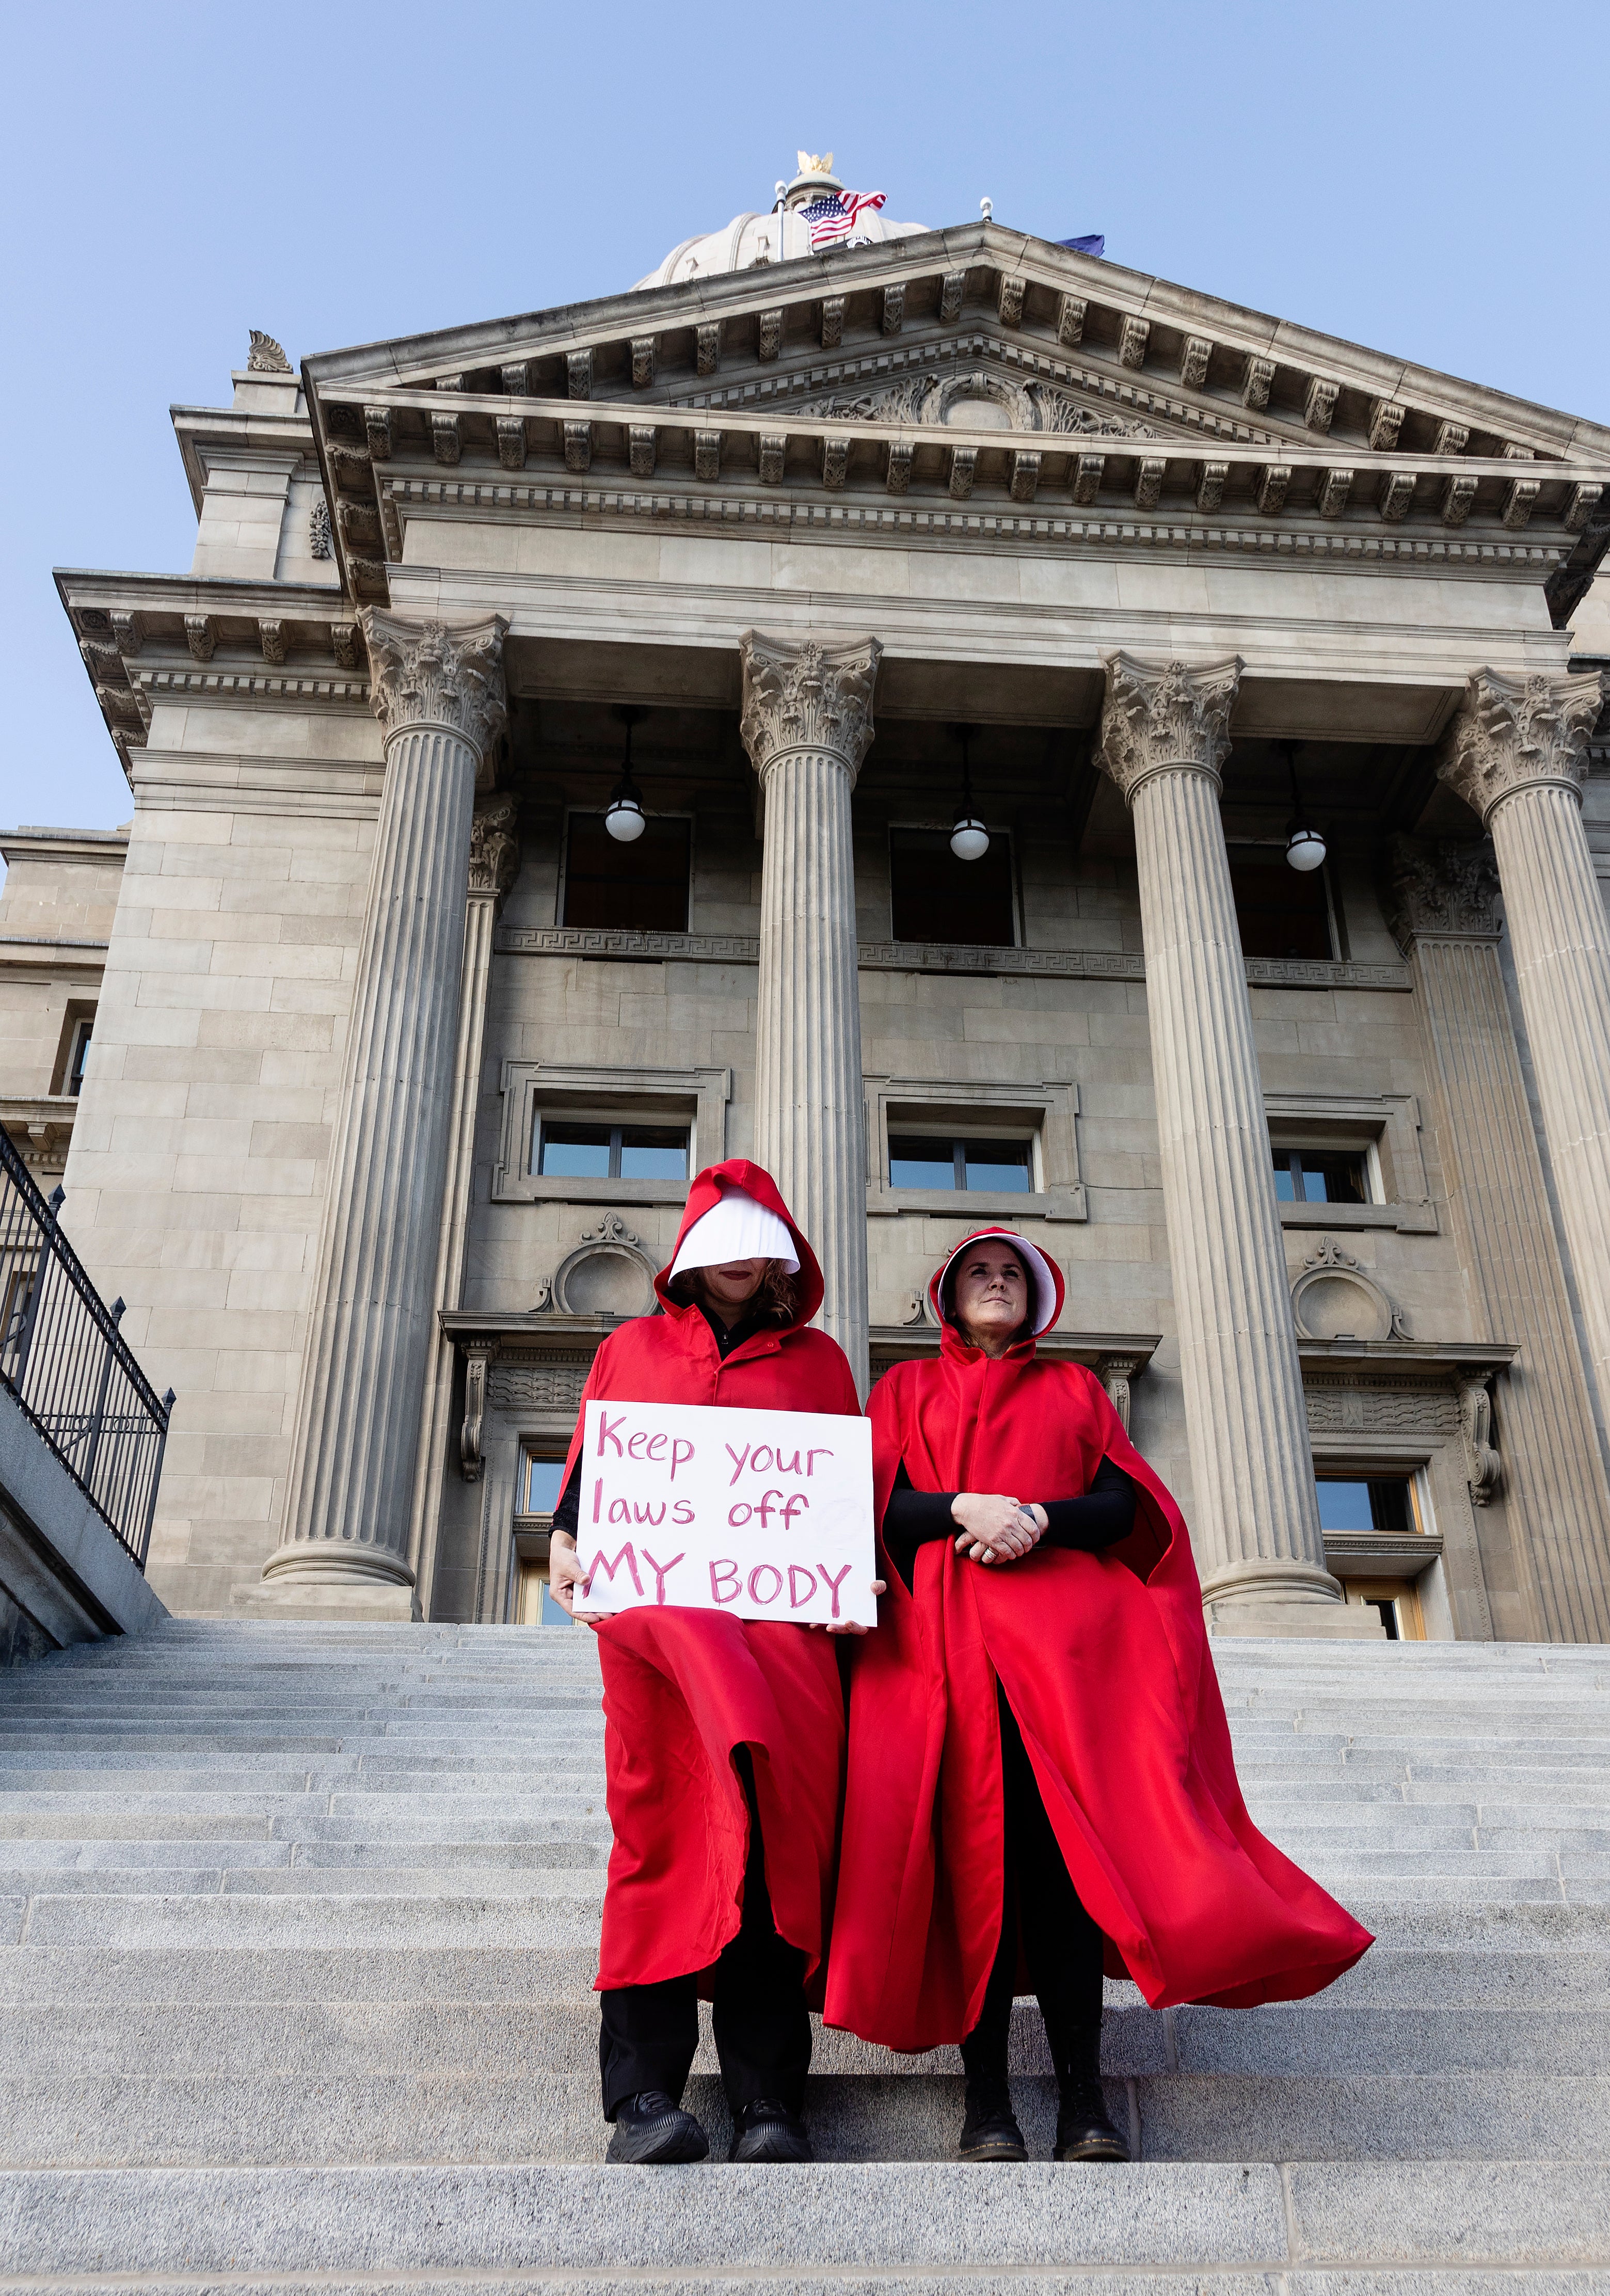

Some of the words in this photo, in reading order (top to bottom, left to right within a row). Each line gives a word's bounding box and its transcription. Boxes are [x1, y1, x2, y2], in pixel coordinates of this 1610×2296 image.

[597, 1410, 695, 1481] Keep
[725, 1443, 834, 1486] your
[593, 1477, 695, 1526] laws
[728, 1489, 810, 1530] off
[582, 1541, 686, 1605] MY
[709, 1558, 852, 1618] BODY
